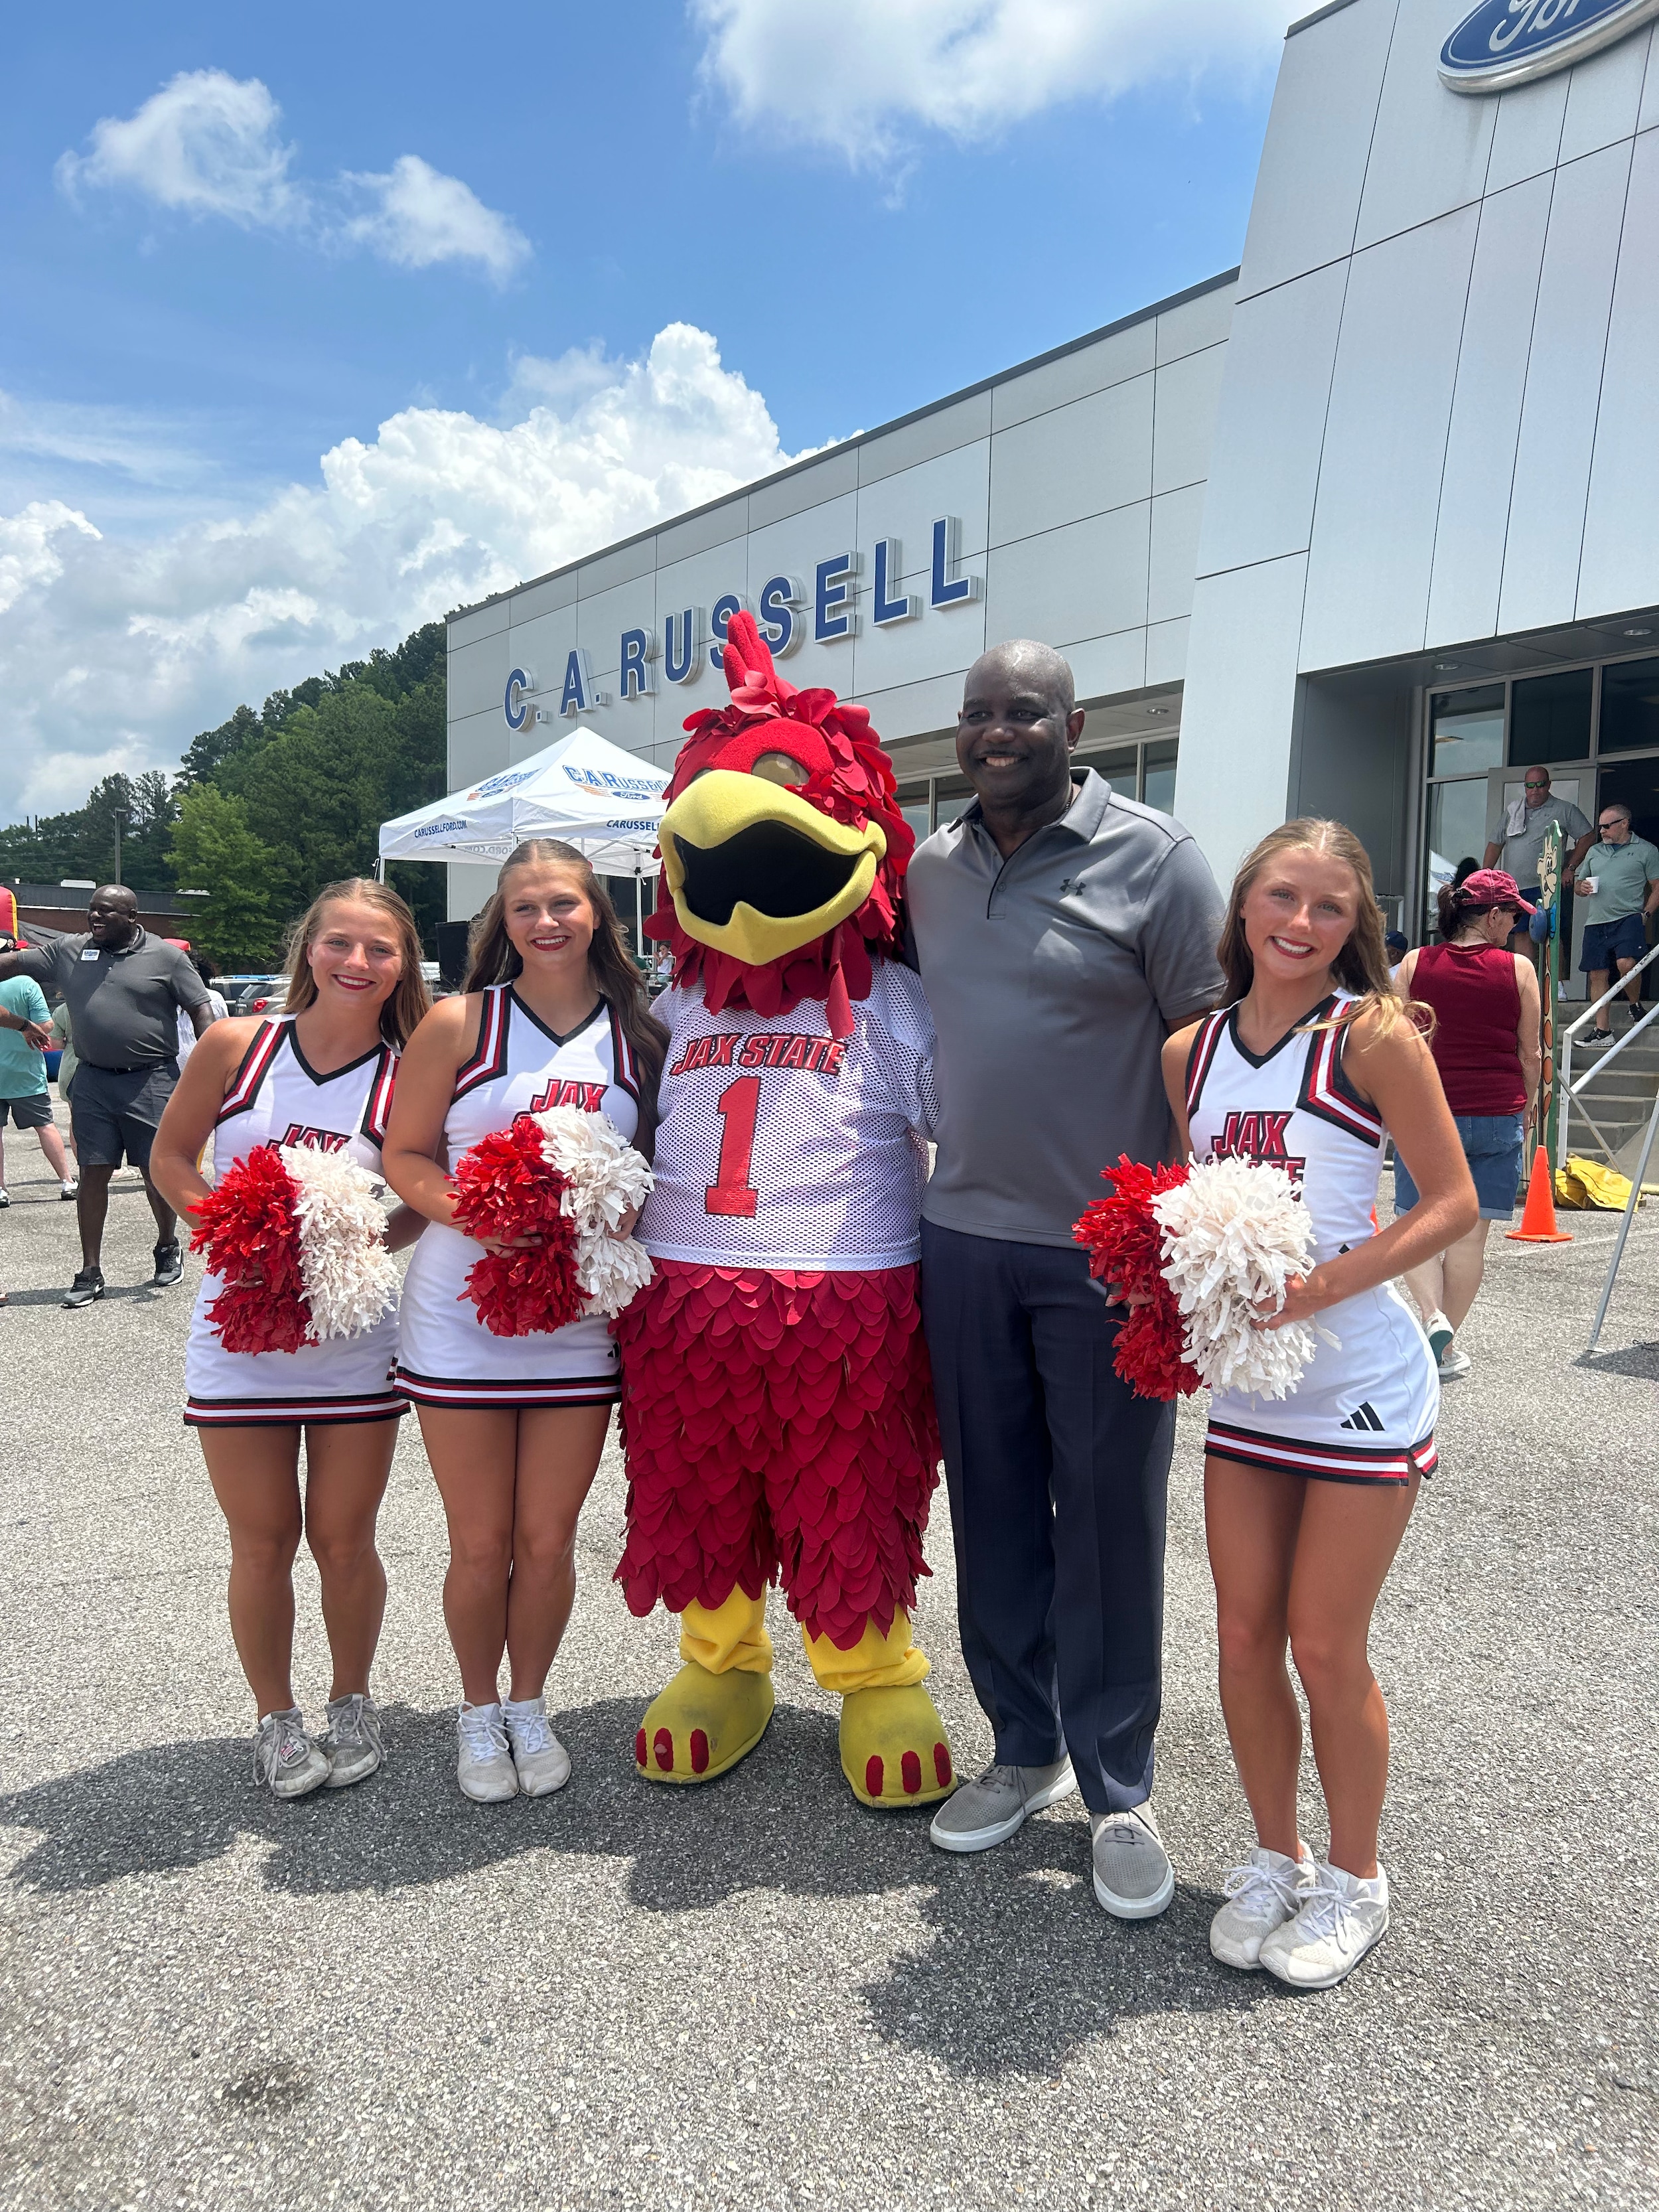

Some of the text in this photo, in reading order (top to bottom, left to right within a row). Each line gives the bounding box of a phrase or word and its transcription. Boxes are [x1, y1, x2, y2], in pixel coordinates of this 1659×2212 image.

[414, 820, 467, 838] CARUSSELLFORD.COM
[669, 1033, 849, 1076] JAX STATE
[530, 1078, 610, 1114] JAX
[705, 1075, 761, 1218] 1
[1211, 1111, 1295, 1156] JAX
